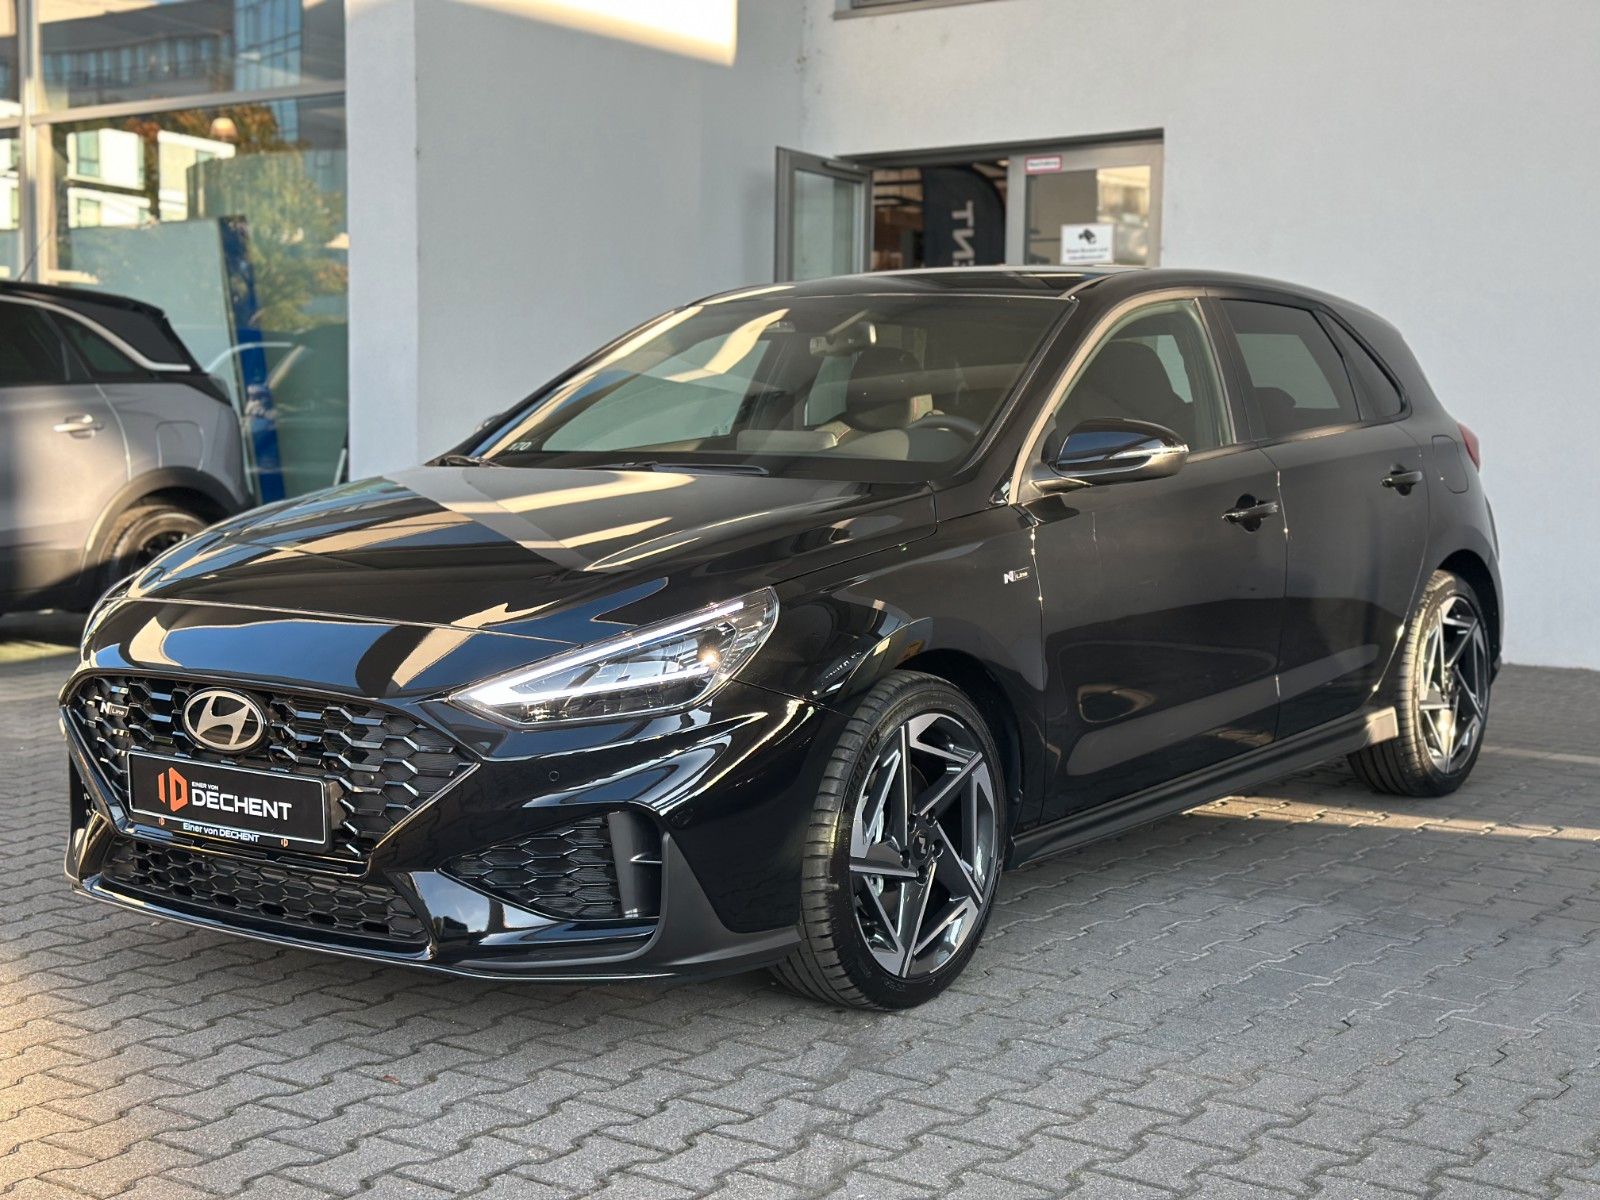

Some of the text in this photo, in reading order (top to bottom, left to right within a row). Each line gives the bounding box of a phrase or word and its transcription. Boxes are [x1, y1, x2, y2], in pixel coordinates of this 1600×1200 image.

[191, 781, 207, 789] EINER
[191, 789, 292, 820] DECHENT
[183, 822, 260, 842] Einer von DECHENT
